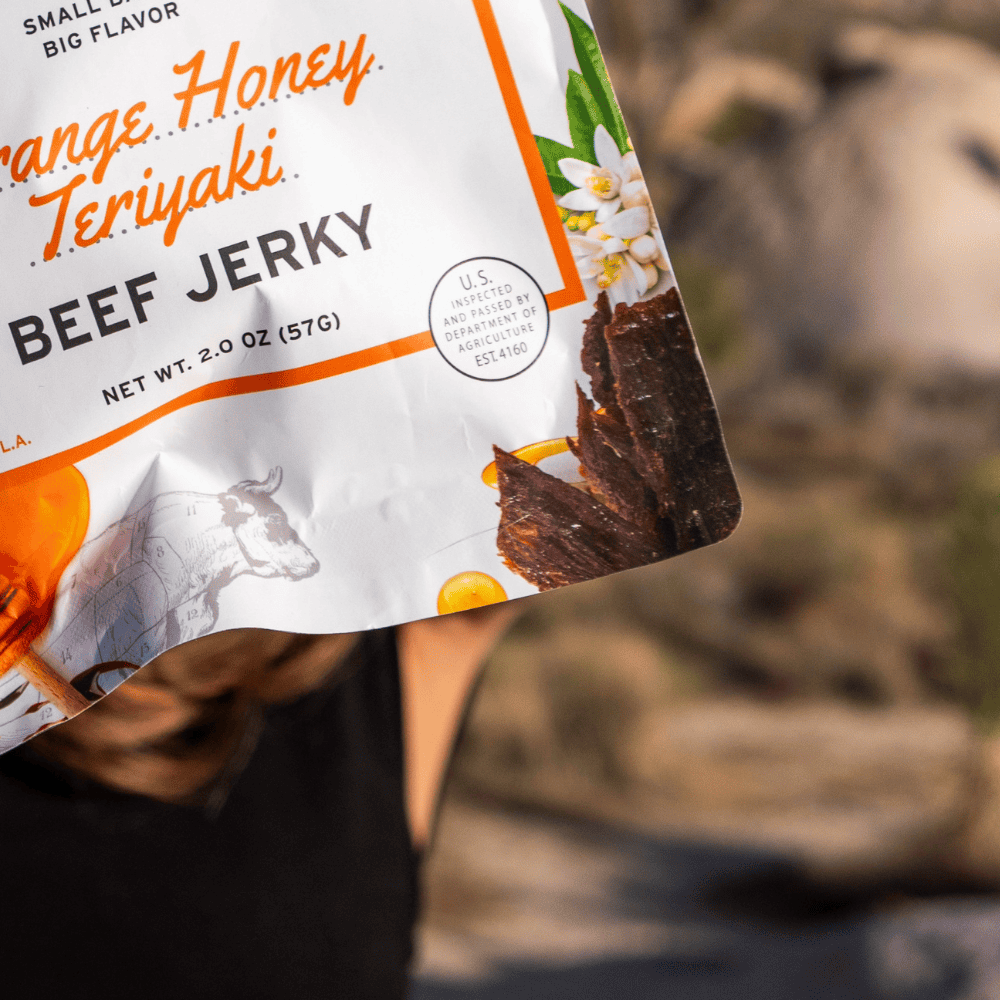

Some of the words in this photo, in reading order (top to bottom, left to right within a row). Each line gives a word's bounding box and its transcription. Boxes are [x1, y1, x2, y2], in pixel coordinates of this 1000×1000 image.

[43, 32, 83, 59] BIG
[90, 1, 180, 42] FLAVOR
[172, 33, 375, 129] Honey
[29, 122, 283, 261] Teriyaki
[8, 271, 158, 366] BEEF
[186, 203, 373, 303] JERKY
[451, 283, 513, 309] INSPECTED
[443, 312, 467, 327] AND
[471, 299, 513, 318] PASSED
[516, 293, 530, 305] BY
[445, 312, 518, 342] DEPARTMENT
[522, 306, 537, 318] OF
[458, 322, 535, 353] AGRICULTURE
[499, 341, 528, 359] 4160
[102, 375, 146, 406] NET
[153, 358, 193, 383] WT.
[197, 338, 234, 363] 2.0
[241, 329, 272, 350] OZ
[278, 312, 342, 345] (57G)
[0, 434, 32, 453] L.A.
[156, 545, 165, 558] 8
